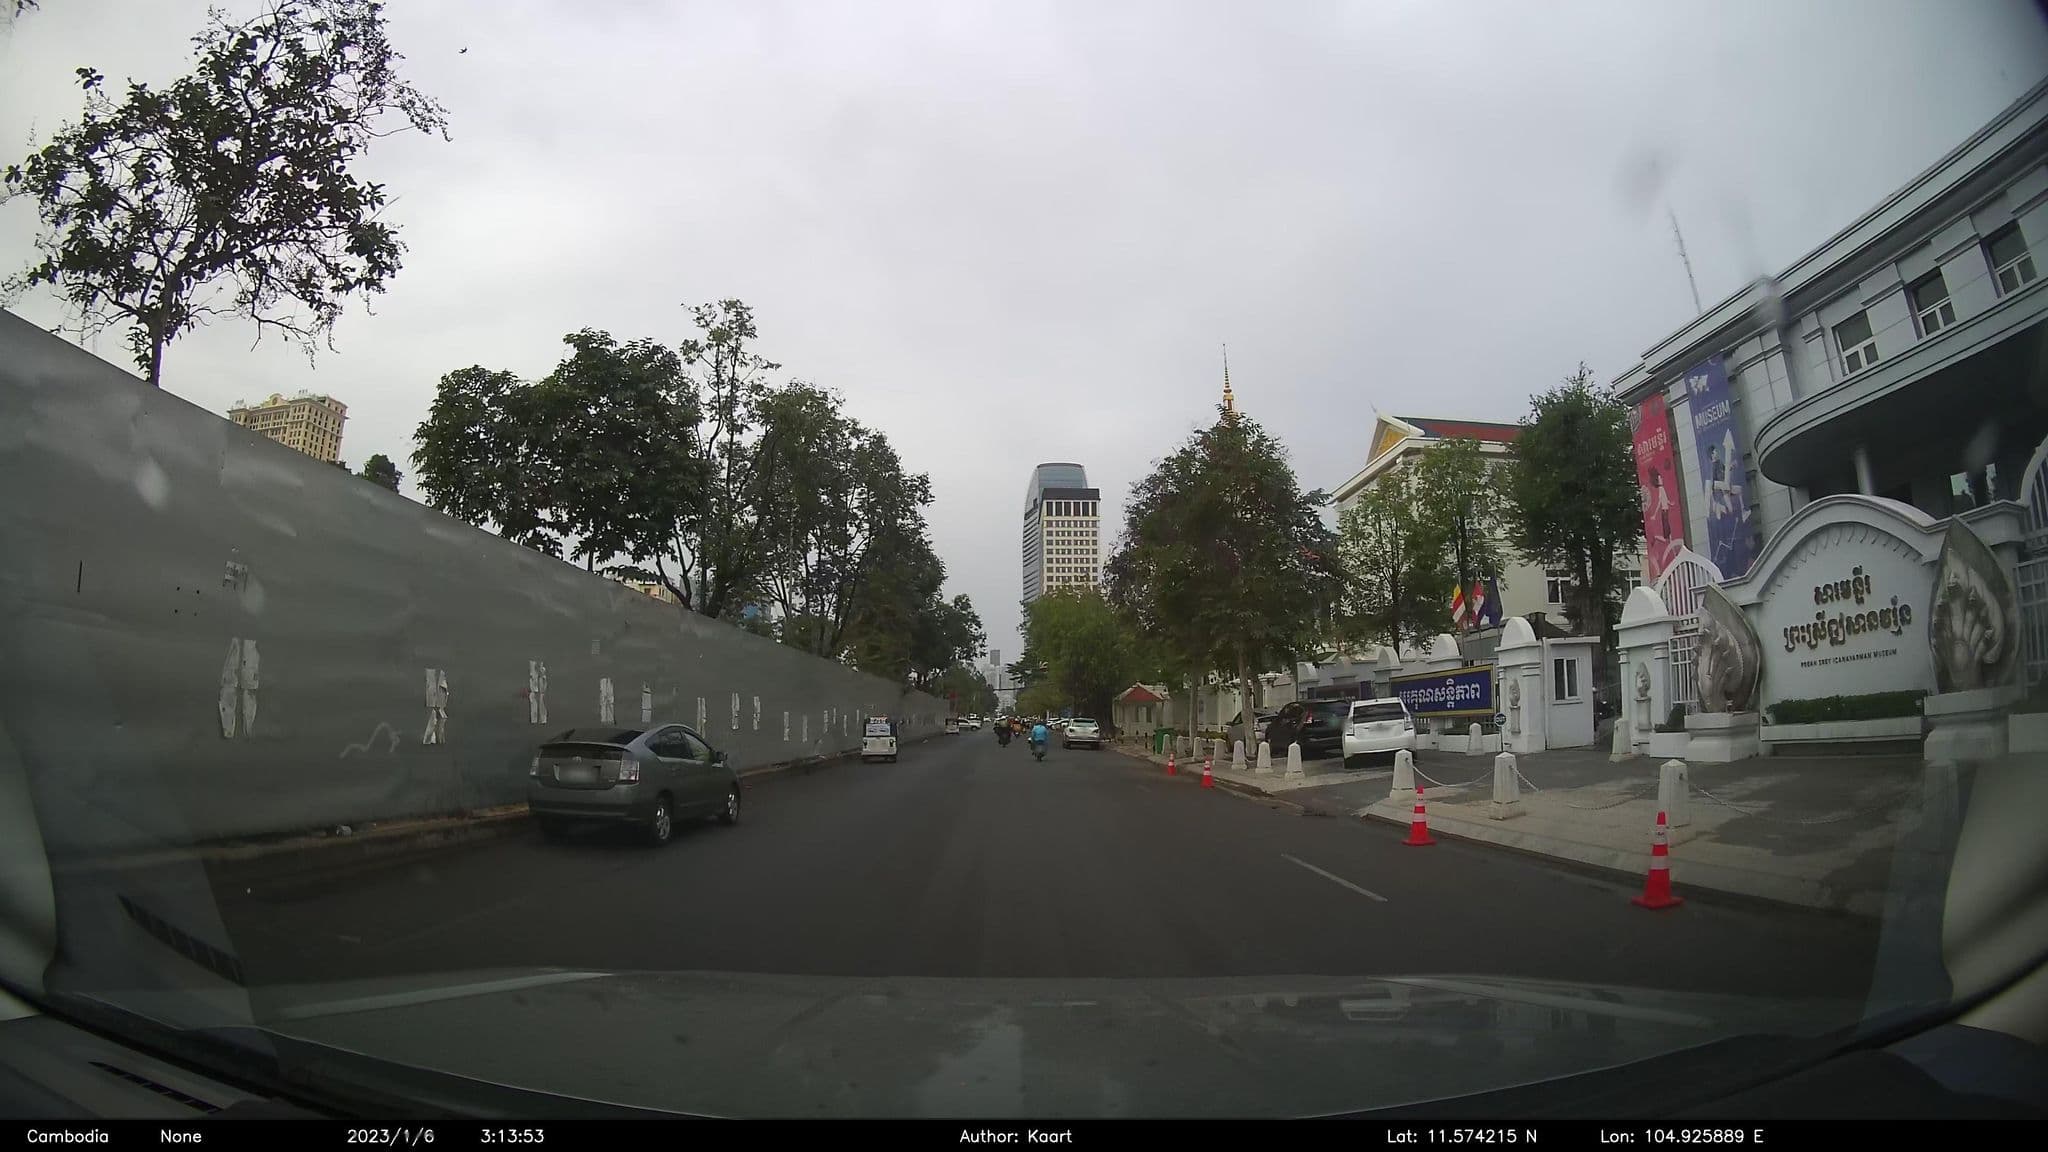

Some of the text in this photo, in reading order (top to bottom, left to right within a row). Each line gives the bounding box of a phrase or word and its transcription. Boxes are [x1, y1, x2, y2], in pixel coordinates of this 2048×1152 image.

[1694, 400, 1731, 429] MUSEUM
[1813, 565, 1872, 605] សារមន្ទីរ
[1873, 648, 1897, 658] MUSEUM
